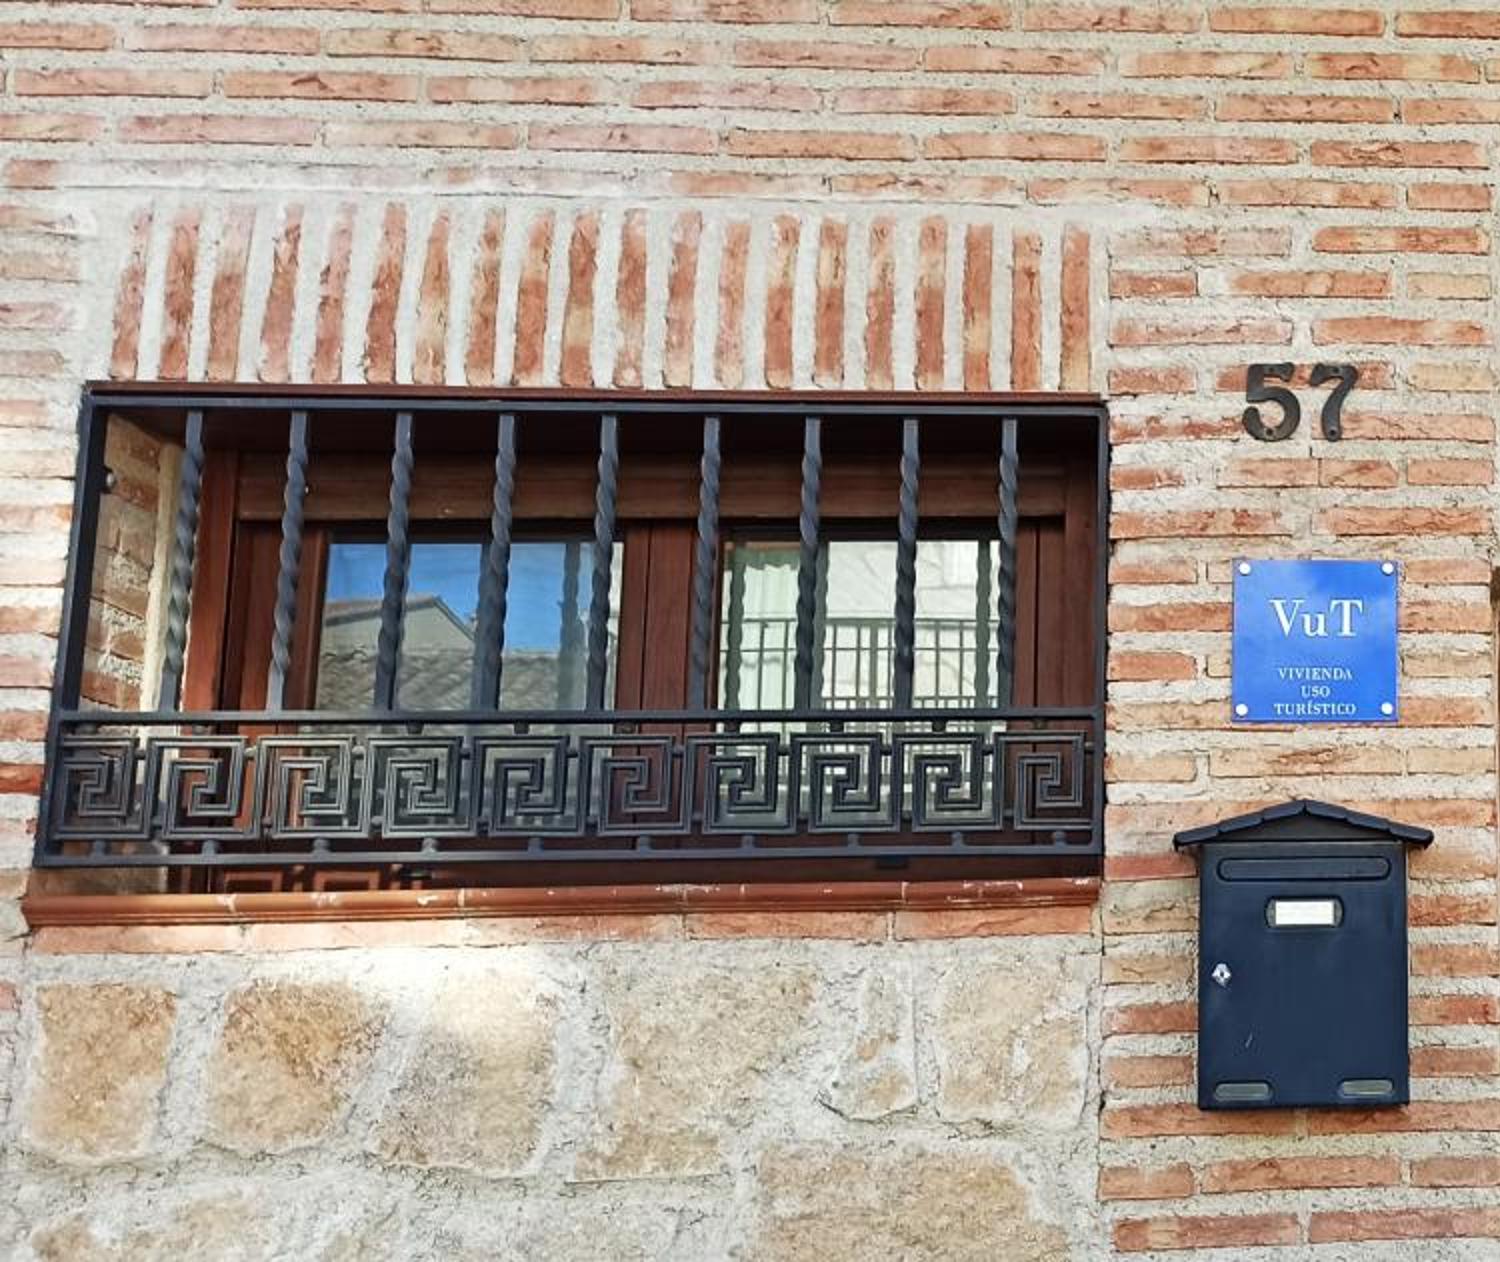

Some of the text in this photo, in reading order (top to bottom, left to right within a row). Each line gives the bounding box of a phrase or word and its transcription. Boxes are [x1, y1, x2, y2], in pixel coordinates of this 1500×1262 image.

[1243, 362, 1358, 442] 57
[1269, 599, 1363, 637] VuT
[1278, 666, 1353, 681] VIVIENDA
[1300, 685, 1331, 698] USO
[1273, 701, 1357, 716] TURÍSTICO
